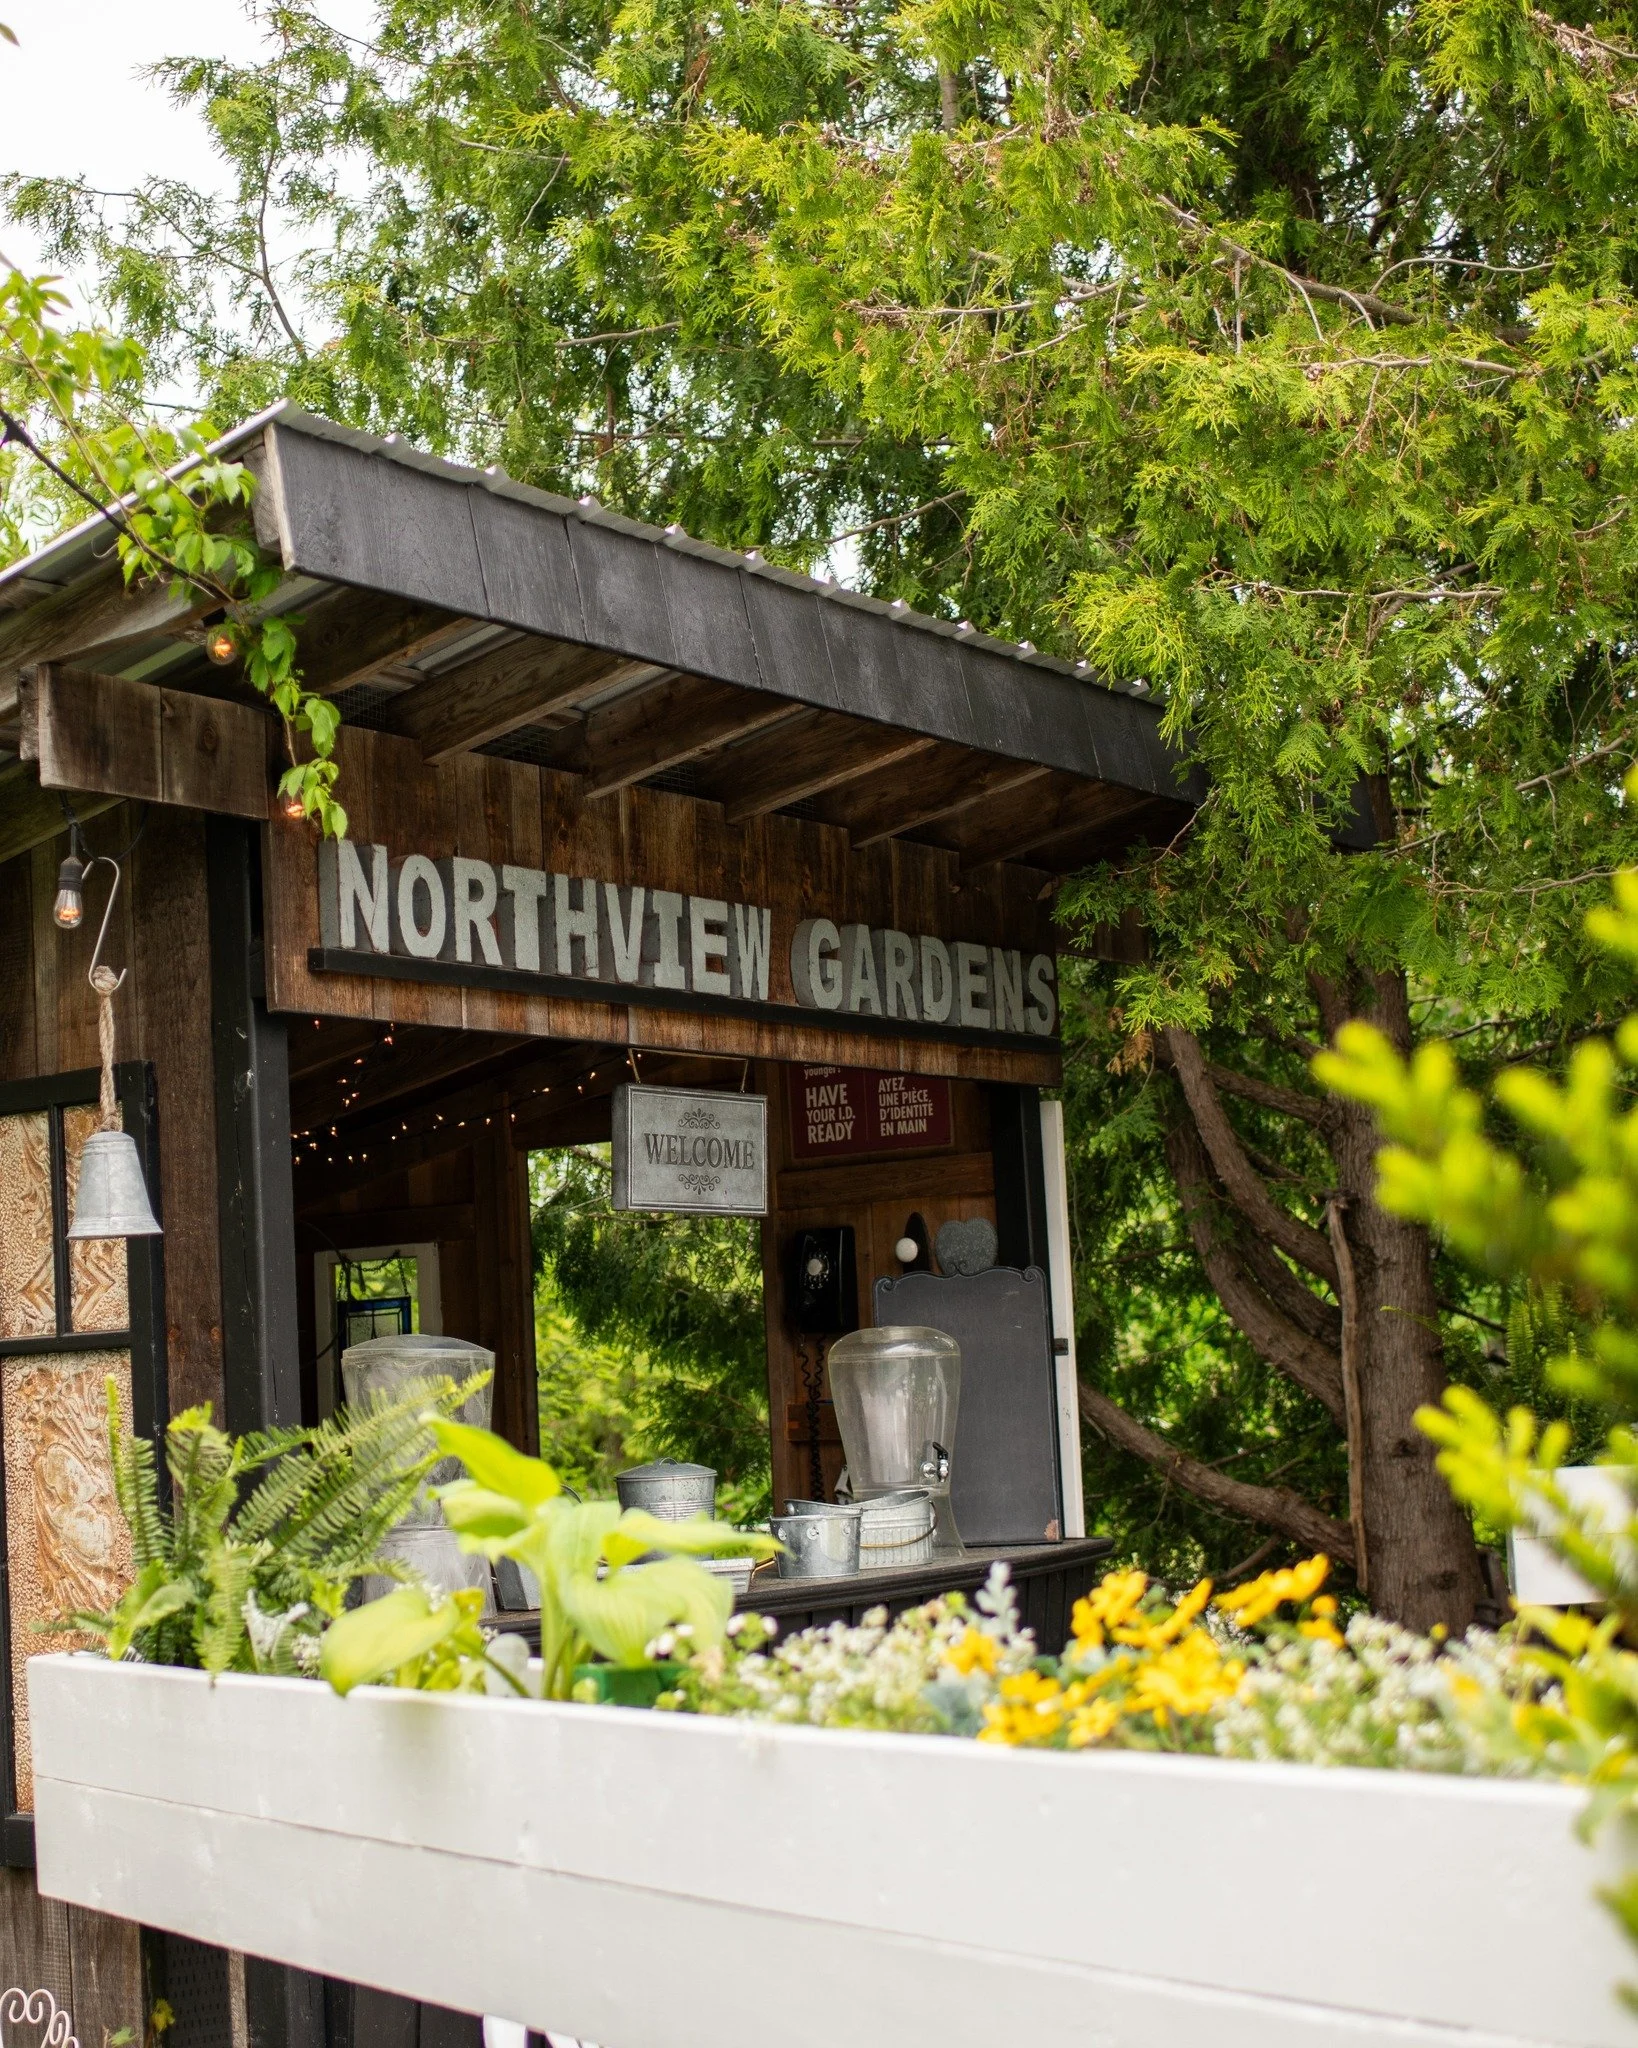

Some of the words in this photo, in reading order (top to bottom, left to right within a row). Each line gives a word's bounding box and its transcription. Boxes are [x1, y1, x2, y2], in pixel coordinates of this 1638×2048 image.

[336, 842, 772, 1001] NORTHVIEW
[806, 918, 1057, 1036] GARDENS
[878, 1077, 905, 1092] AYEZ
[805, 1084, 848, 1108] HAVE
[879, 1093, 899, 1107] UNE
[901, 1087, 928, 1104] PIÈCE
[806, 1108, 834, 1123] YOUR
[838, 1106, 856, 1120] I.D.
[807, 1121, 854, 1144] READY
[880, 1122, 894, 1136] EN
[897, 1118, 927, 1135] MAIN
[644, 1132, 755, 1170] WELCOME
